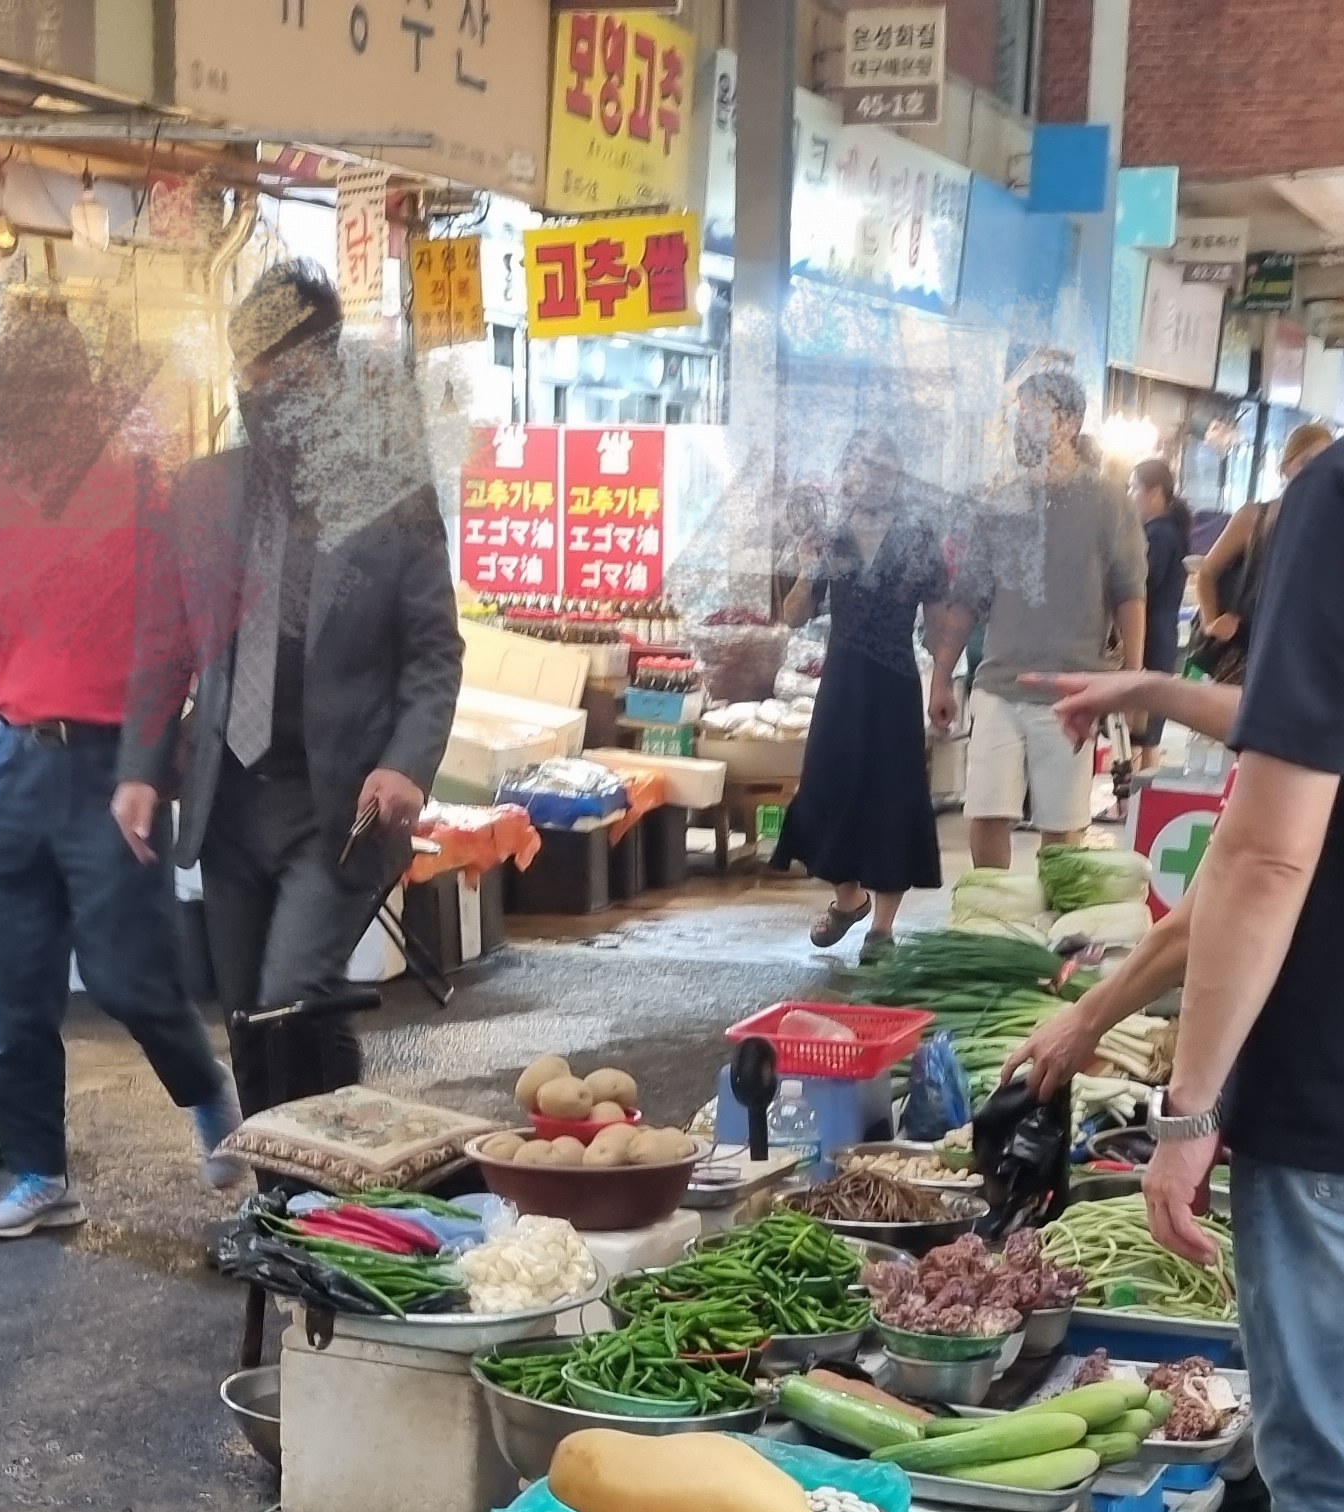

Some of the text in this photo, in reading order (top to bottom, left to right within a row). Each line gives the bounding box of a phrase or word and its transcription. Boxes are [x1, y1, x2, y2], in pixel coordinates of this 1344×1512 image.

[492, 425, 529, 469] 쌀
[596, 430, 634, 475] 쌀
[464, 478, 554, 513] 고추가루
[568, 485, 660, 520] 고추가루
[464, 515, 555, 549] エゴマ油
[568, 523, 659, 556] エゴマ油
[476, 551, 543, 585] ゴマ油
[580, 559, 648, 592] ゴマ油
